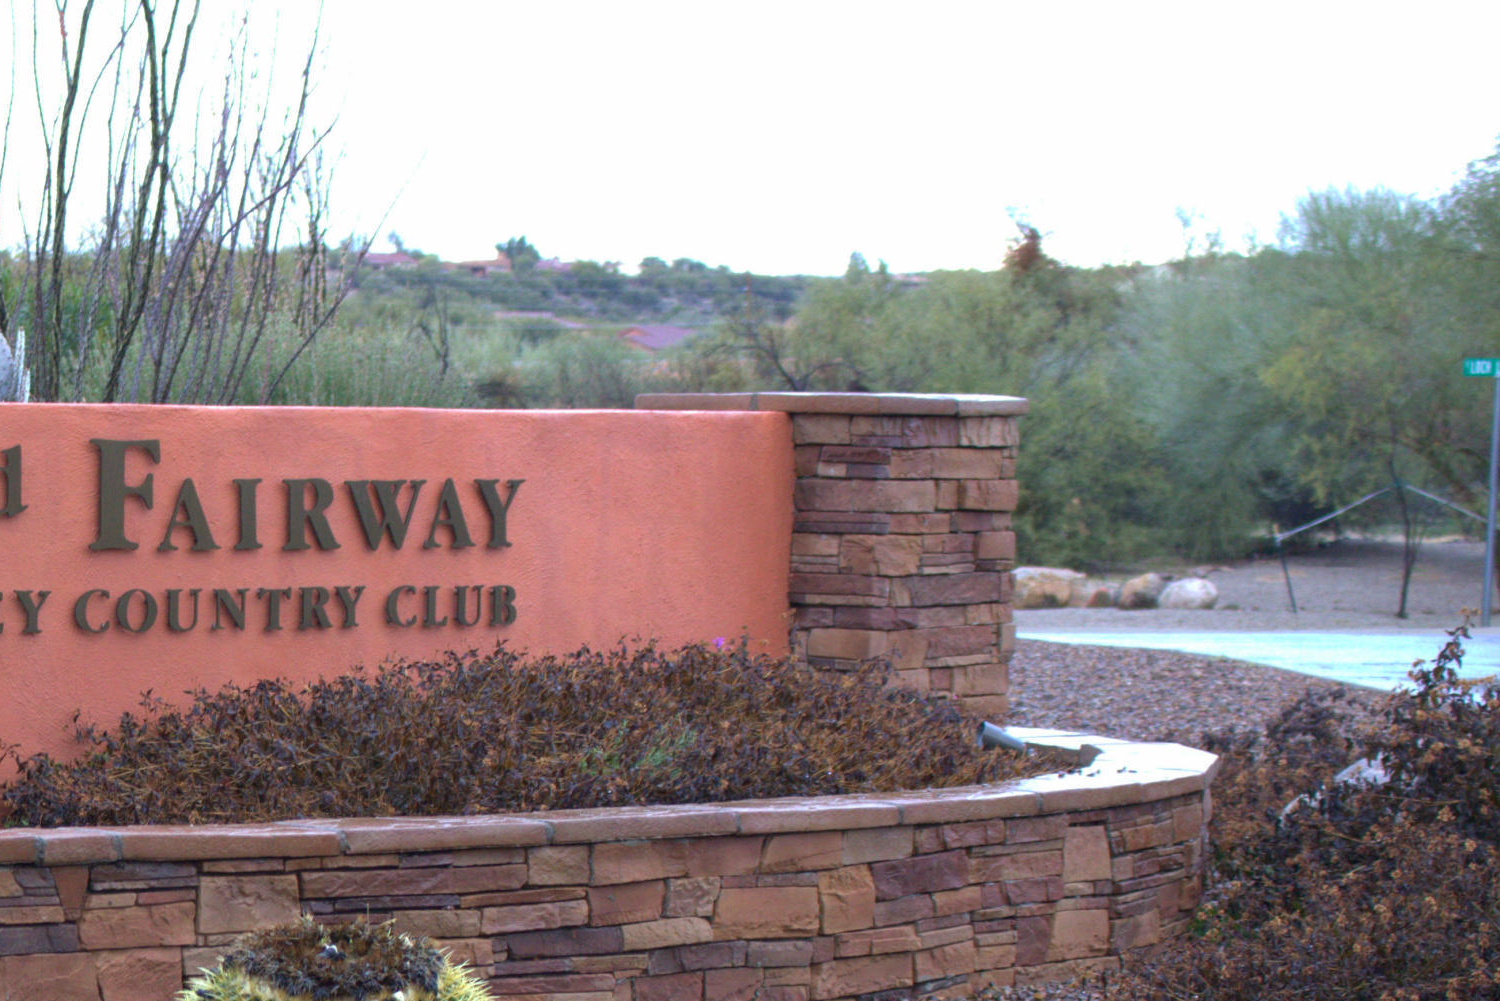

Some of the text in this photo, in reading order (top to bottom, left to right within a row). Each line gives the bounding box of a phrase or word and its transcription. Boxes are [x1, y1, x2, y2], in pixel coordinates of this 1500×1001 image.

[86, 438, 526, 556] FAIRWAY
[71, 586, 367, 638] COUNTRY
[382, 584, 518, 631] CLUB
